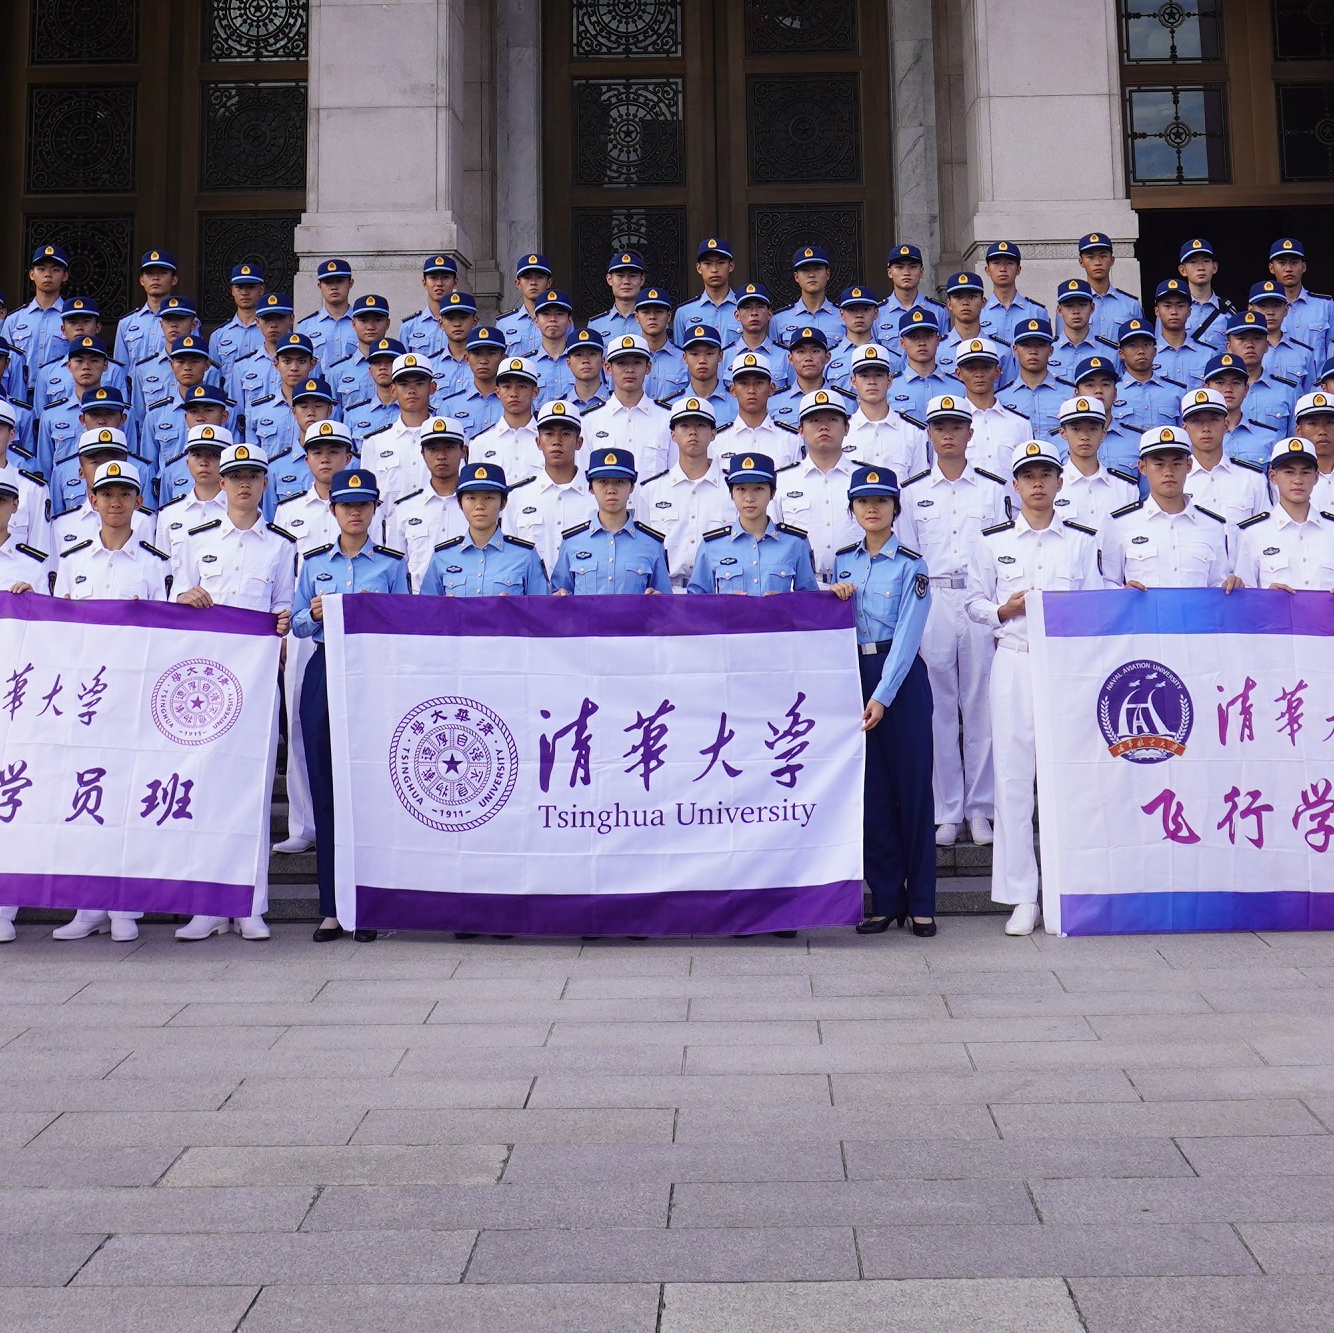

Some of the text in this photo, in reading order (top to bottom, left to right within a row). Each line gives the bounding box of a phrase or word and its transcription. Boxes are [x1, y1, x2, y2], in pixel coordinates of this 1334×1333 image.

[1106, 662, 1183, 691] NAVAL AVIATION UNIVERSITY
[160, 689, 174, 729] TSINGHUA
[401, 747, 505, 808] TSINGHUA UNIVERSITY
[538, 798, 817, 835] Tsinghua University
